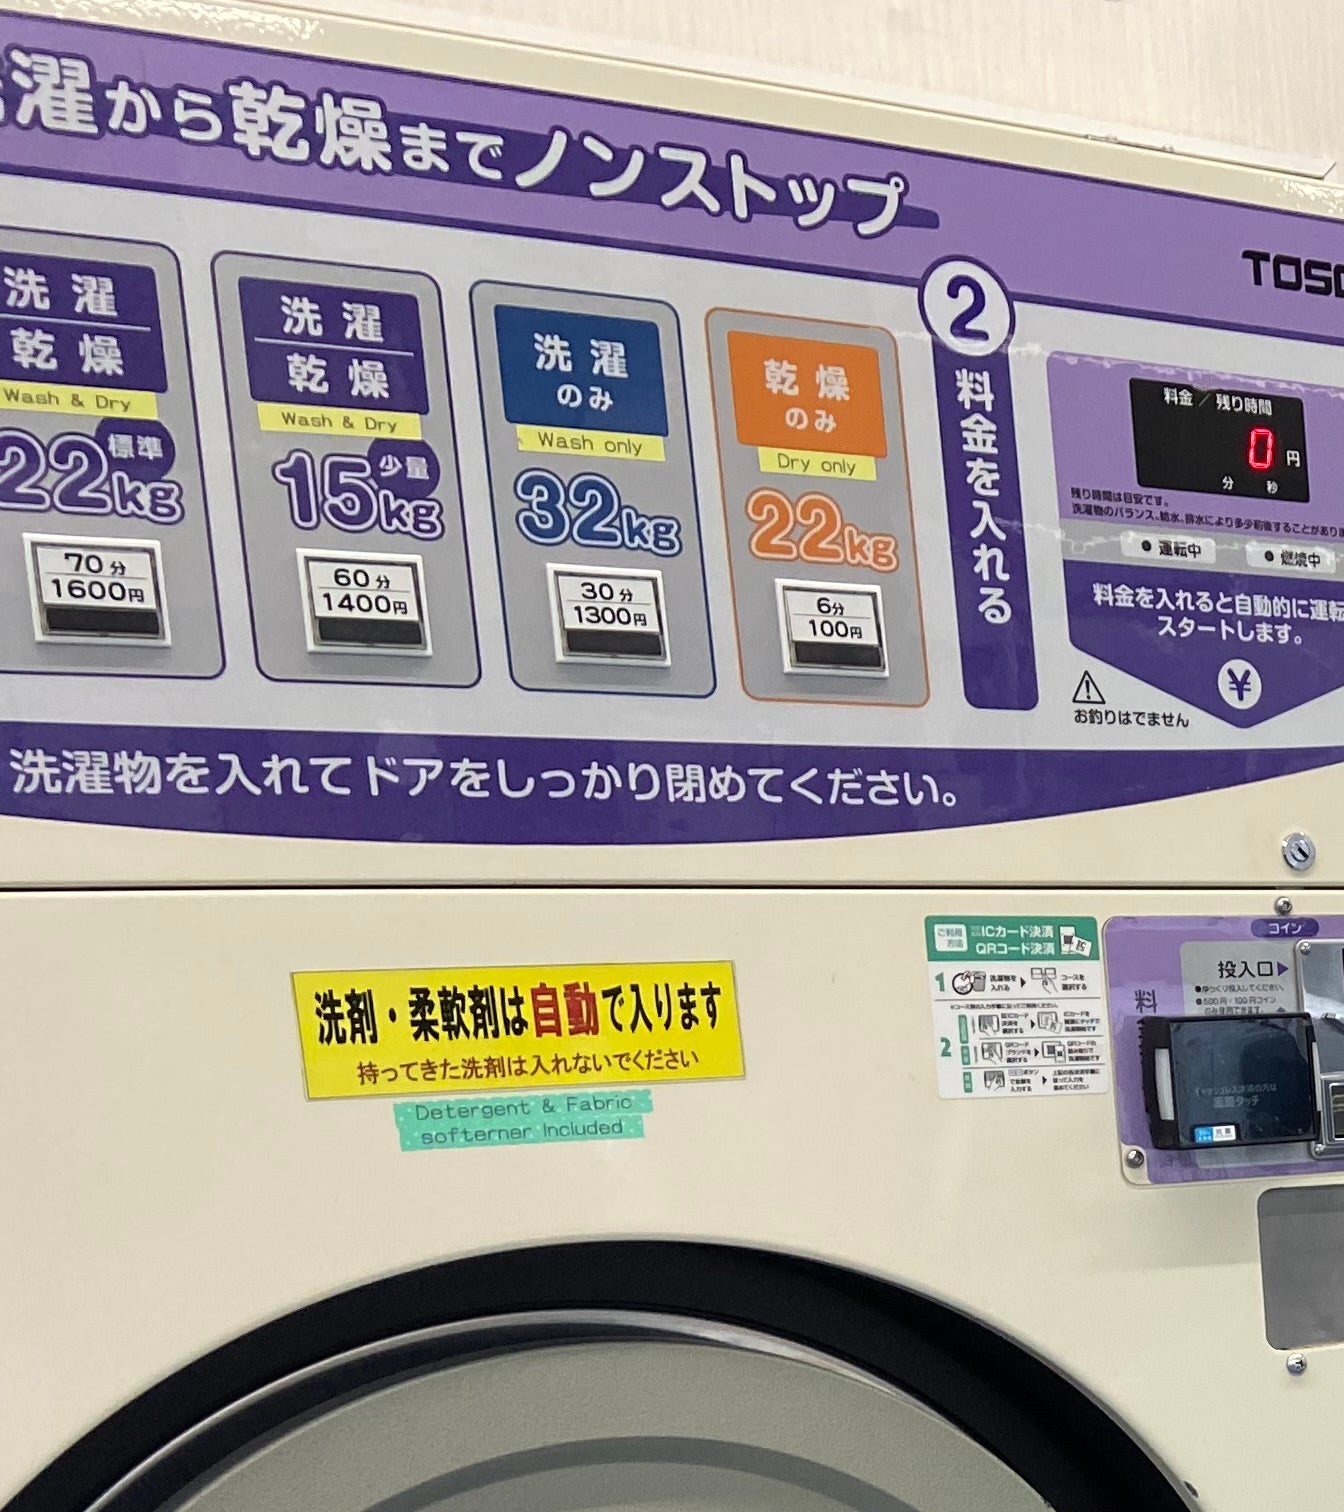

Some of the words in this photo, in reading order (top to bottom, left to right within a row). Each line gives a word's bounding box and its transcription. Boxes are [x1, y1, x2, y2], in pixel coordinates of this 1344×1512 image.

[0, 48, 905, 238] 濯から乾燥までノンストップ
[3, 266, 119, 317] 洗濯
[280, 295, 386, 345] 洗濯
[946, 276, 990, 342] 2
[9, 327, 125, 377] 乾燥
[533, 333, 629, 379] 洗濯
[286, 353, 390, 400] 乾燥
[764, 357, 851, 401] 乾燥
[3, 388, 62, 409] Wash
[70, 392, 86, 409] &
[96, 394, 131, 414] Dry
[556, 384, 614, 412] のみ
[1163, 387, 1193, 407] 料金
[1216, 393, 1273, 416] 残り時間
[281, 411, 334, 430] Wash
[343, 414, 357, 431] &
[367, 416, 398, 435] Dry
[785, 405, 838, 435] のみ
[108, 432, 163, 461] 標準
[537, 431, 592, 452] Wash
[600, 436, 643, 457] only
[1248, 428, 1275, 469] 0
[378, 453, 431, 482] 少量
[776, 453, 814, 476] Dry
[821, 458, 857, 479] only
[272, 449, 444, 540] 15kg
[956, 368, 1012, 625] 料金を入れる
[1070, 487, 1169, 507] 残り時間は目安です。
[513, 467, 683, 556] 32kg
[746, 487, 899, 572] 22kg
[1159, 539, 1201, 558] 運転中
[1281, 550, 1321, 568] 燃焼中
[64, 552, 127, 577] 70分
[50, 577, 145, 604] 1600円
[333, 567, 391, 590] 60分
[321, 592, 408, 617] 1400円
[580, 582, 633, 603] 30分
[572, 604, 647, 627] 1300円
[816, 596, 844, 618] 6分
[807, 618, 863, 641] 100円
[1158, 613, 1304, 646] スタートします。
[1073, 707, 1190, 729] お釣りはでません
[10, 747, 958, 806] 洗濯物を入れてドアをしっかり閉めてください。
[981, 925, 1054, 938] ICカード決済
[1268, 923, 1303, 935] コイン
[976, 942, 1055, 956] QRコード決済
[1218, 960, 1274, 978] 投入口
[313, 974, 725, 1047] 洗剤・柔軟剤は自動で入ります
[355, 1045, 701, 1085] 持ってきた洗剤は入れないでください
[416, 1099, 530, 1121] Detergent
[542, 1098, 555, 1113] &
[566, 1095, 632, 1112] Fabric
[421, 1127, 532, 1145] softerner
[543, 1119, 623, 1138] Included
